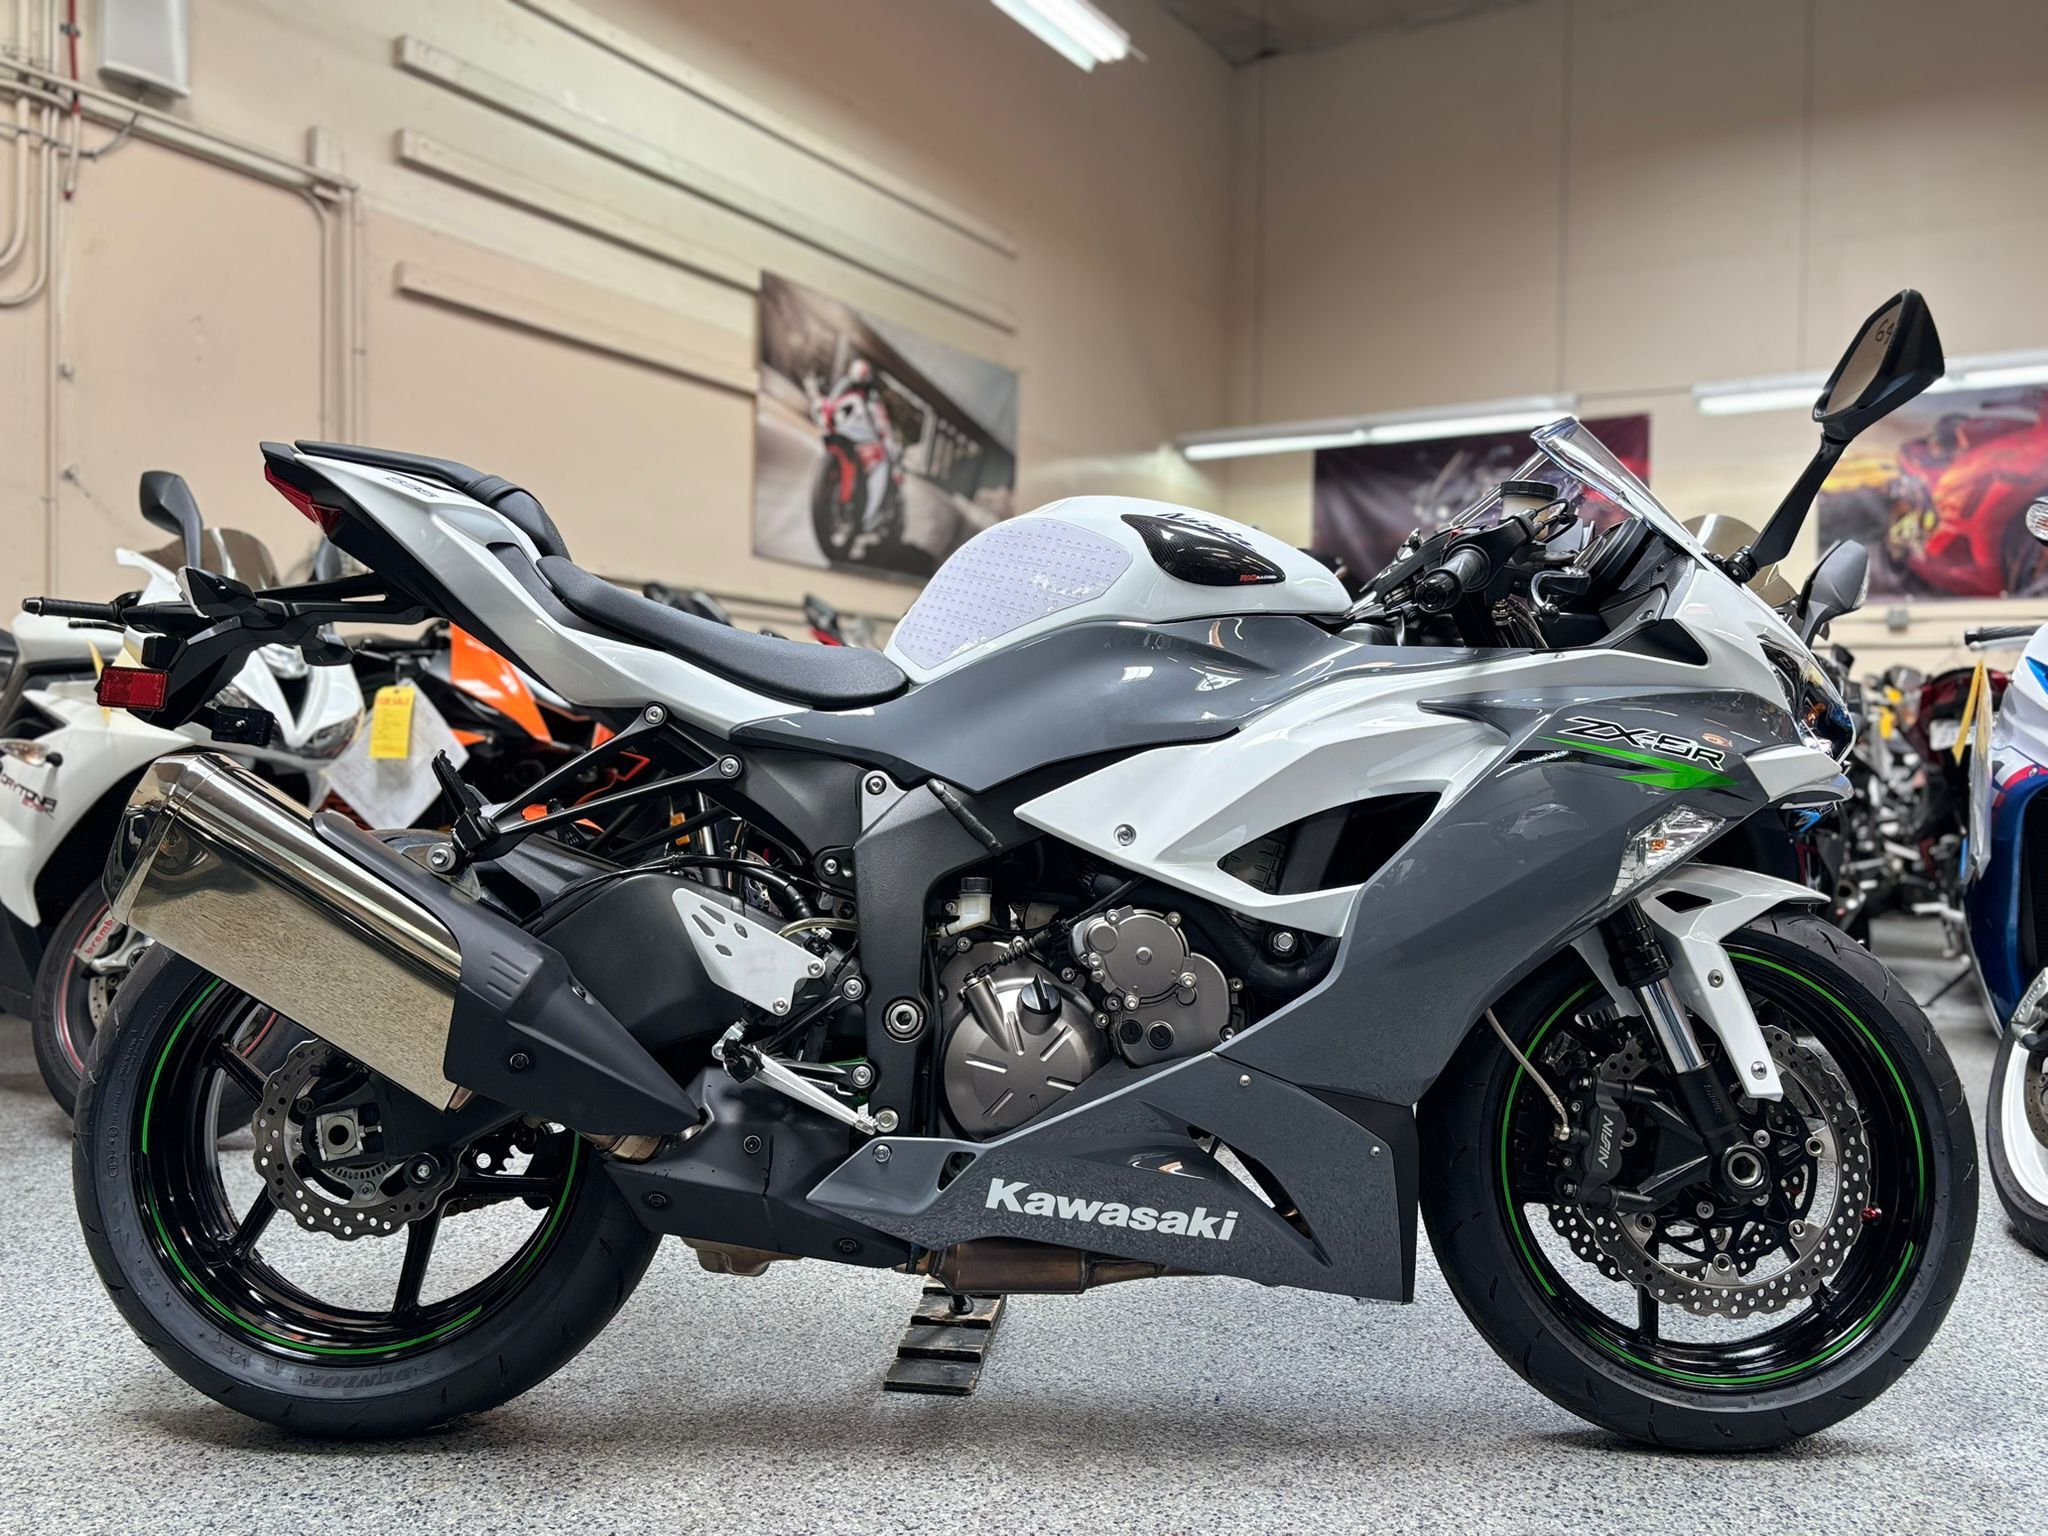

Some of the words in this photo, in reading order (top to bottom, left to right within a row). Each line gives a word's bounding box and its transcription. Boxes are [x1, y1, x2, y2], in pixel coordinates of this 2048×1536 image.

[1556, 715, 1726, 772] ZX-6R
[84, 917, 114, 955] bremb
[984, 1177, 1239, 1241] Kawasaki
